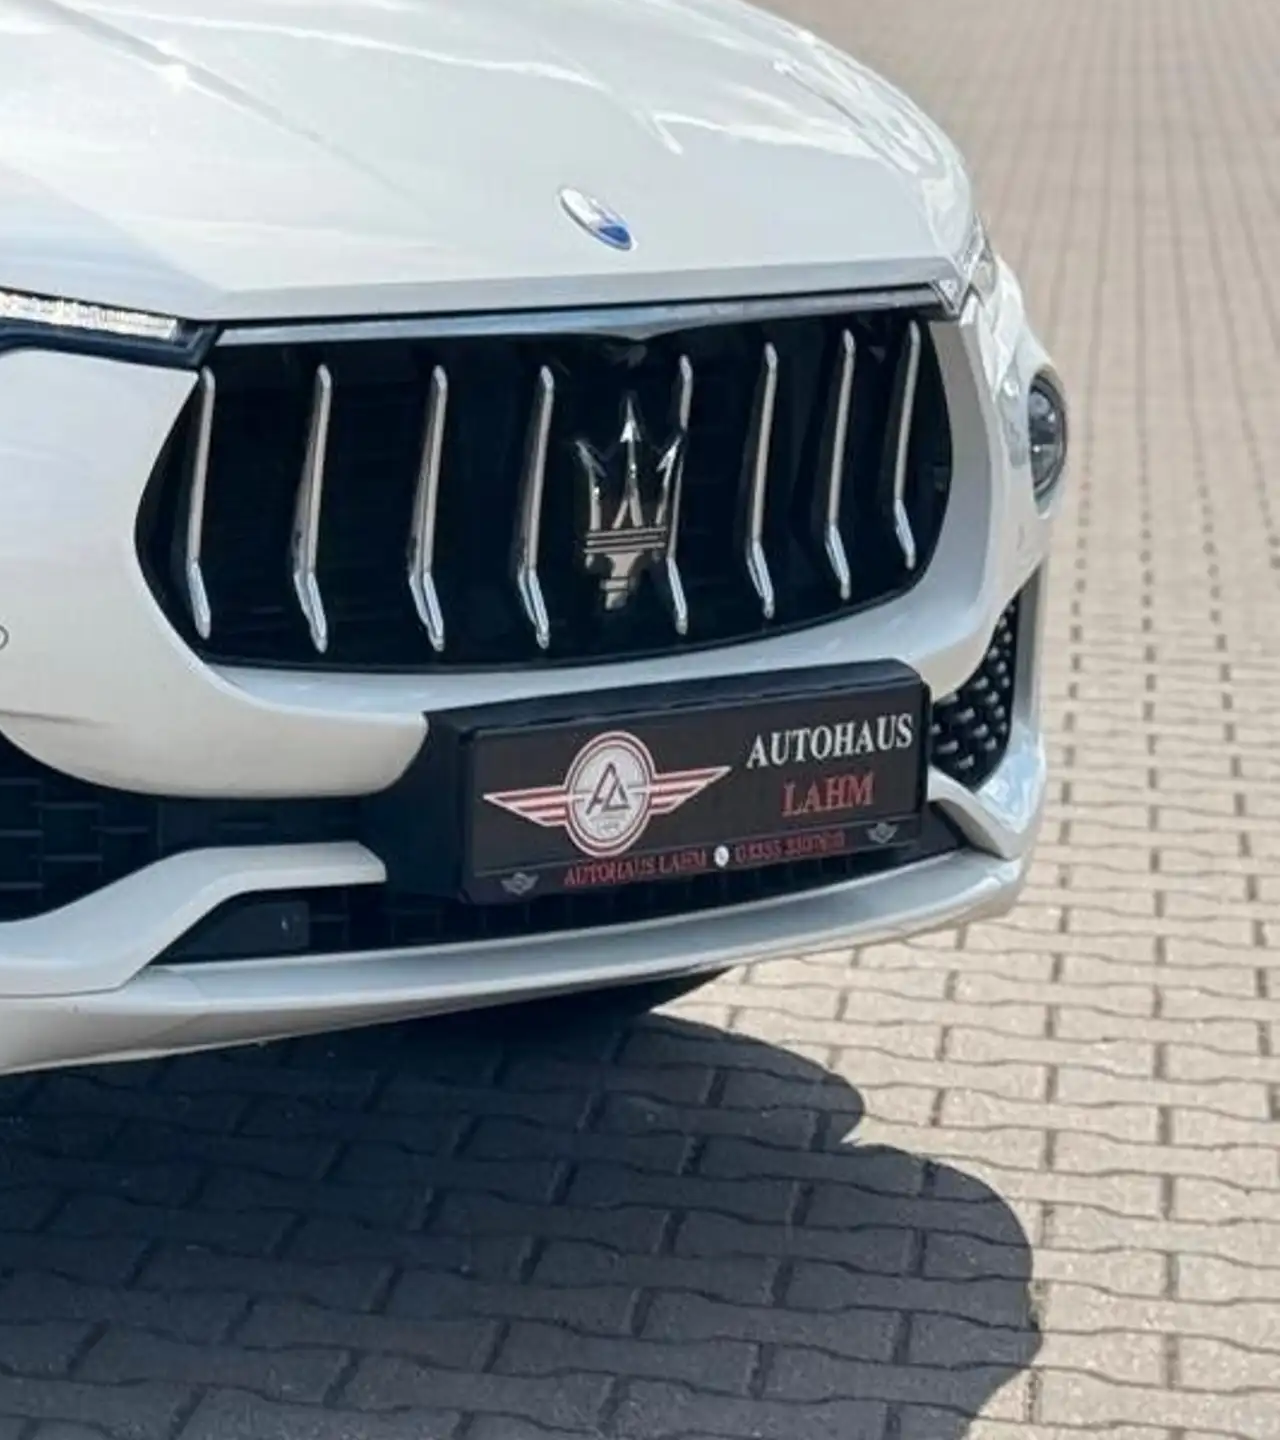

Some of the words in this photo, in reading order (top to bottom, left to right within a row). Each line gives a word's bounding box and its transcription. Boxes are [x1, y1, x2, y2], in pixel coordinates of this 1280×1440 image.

[745, 712, 913, 770] AUTOHAUS
[781, 771, 875, 818] LAHM
[564, 857, 656, 886] AUTOHAUS
